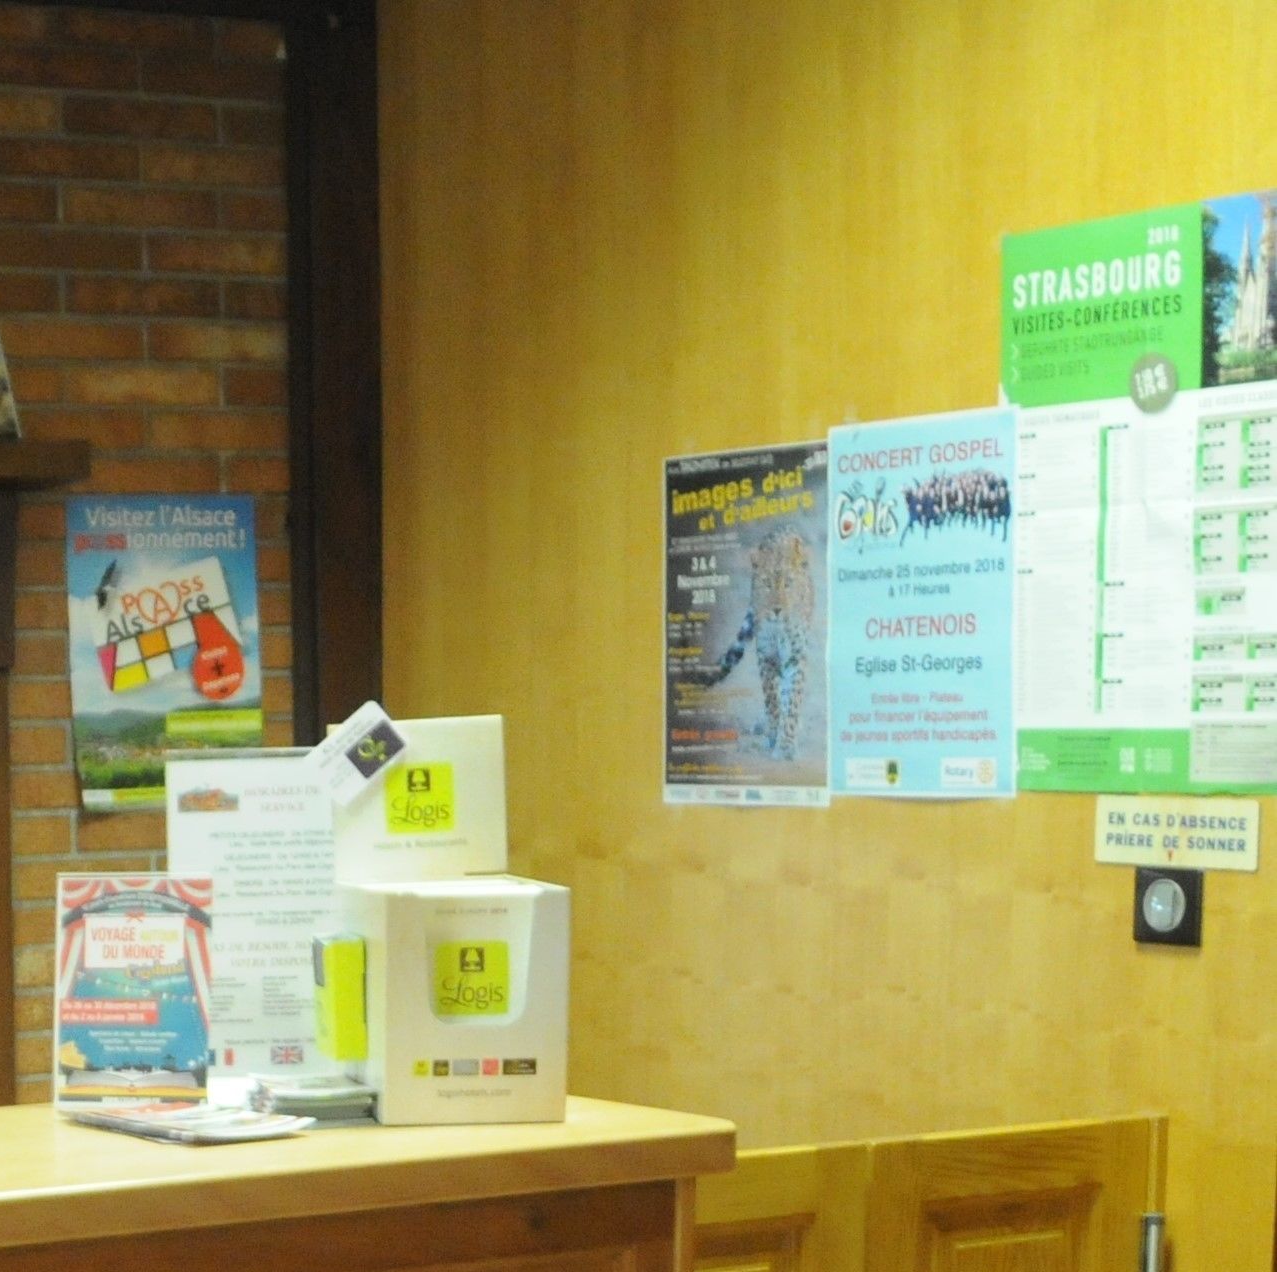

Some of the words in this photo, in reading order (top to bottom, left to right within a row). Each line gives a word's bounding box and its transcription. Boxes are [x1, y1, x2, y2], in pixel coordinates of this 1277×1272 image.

[1013, 250, 1182, 310] STRASBOURG
[1012, 294, 1183, 336] VISITES-CONFÉRENCES
[838, 446, 923, 475] CONCERT
[929, 438, 1004, 464] GOSPEL
[86, 506, 154, 527] Visitez
[159, 504, 236, 527] l'Alsace
[699, 513, 716, 532] et
[722, 491, 815, 526] d'ailleurs
[838, 567, 893, 582] Dimanche
[896, 564, 911, 579] 25
[914, 561, 971, 577] novembre
[975, 557, 1005, 573] 2018
[899, 583, 911, 596] 17
[865, 612, 976, 641] CHATENOIS
[901, 654, 983, 674] St-Georges
[392, 795, 452, 828] Logis
[1108, 811, 1126, 825] EN
[1133, 812, 1161, 827] CAS
[1167, 812, 1247, 831] D'ABSENCE
[1163, 834, 1180, 849] DE
[1187, 838, 1247, 852] SONNER
[91, 927, 136, 942] VOYAGE
[102, 945, 118, 959] DU
[123, 944, 165, 959] MONDE
[440, 973, 504, 1010] Logis
